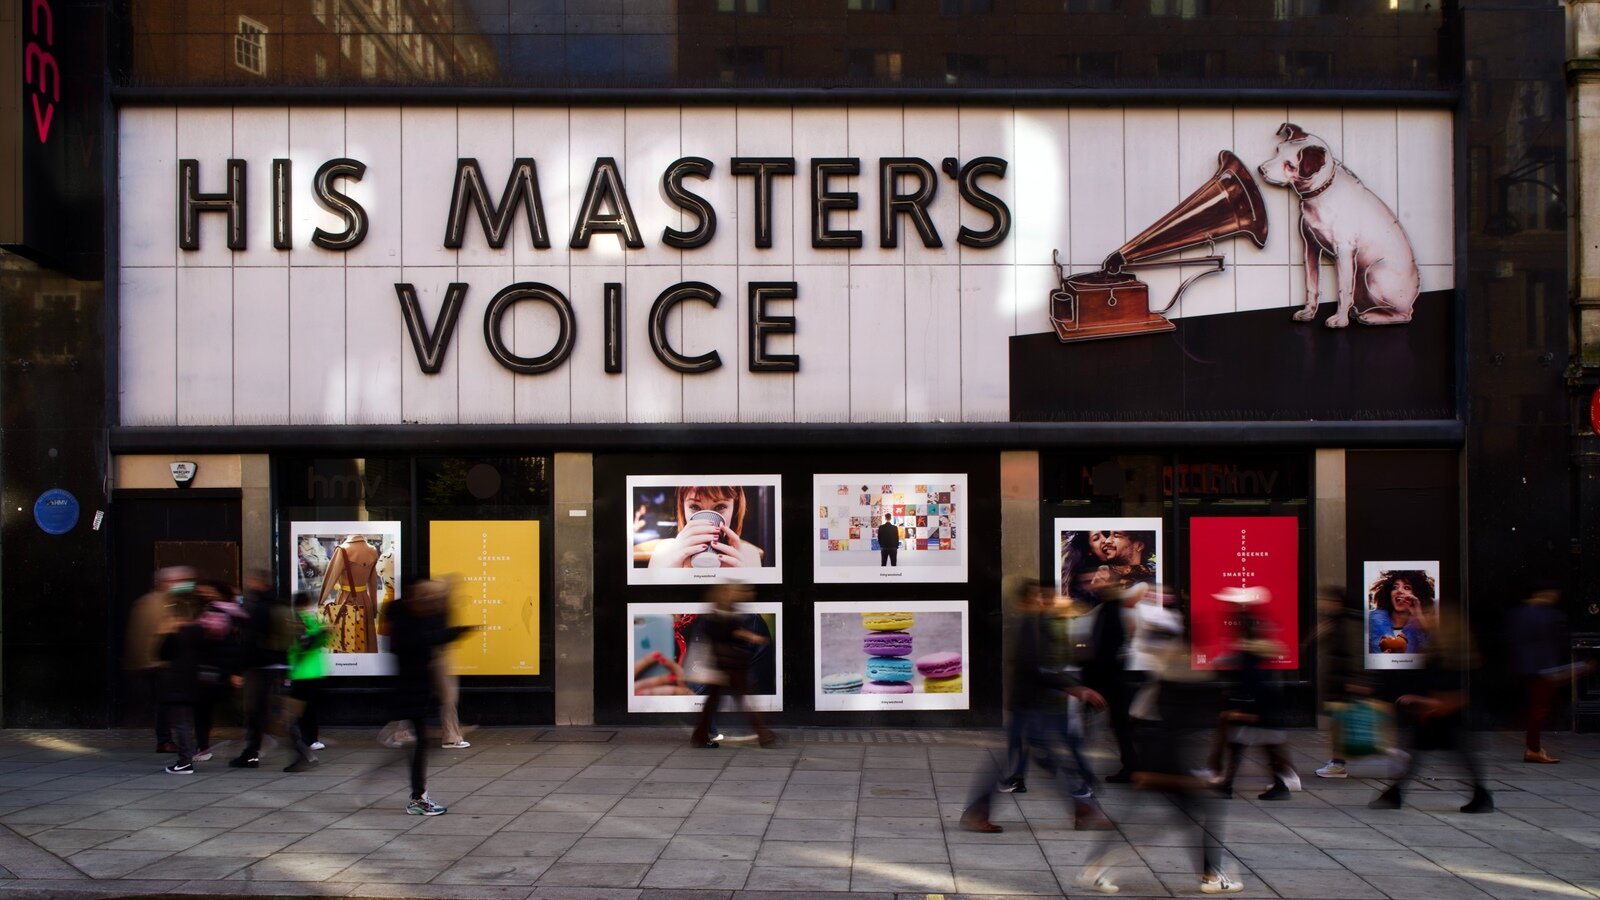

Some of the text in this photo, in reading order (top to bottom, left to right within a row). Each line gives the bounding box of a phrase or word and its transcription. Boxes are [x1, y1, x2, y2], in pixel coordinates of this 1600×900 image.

[178, 156, 1012, 250] HIS MASTER'S
[394, 281, 800, 375] VOICE
[308, 466, 381, 499] hmv
